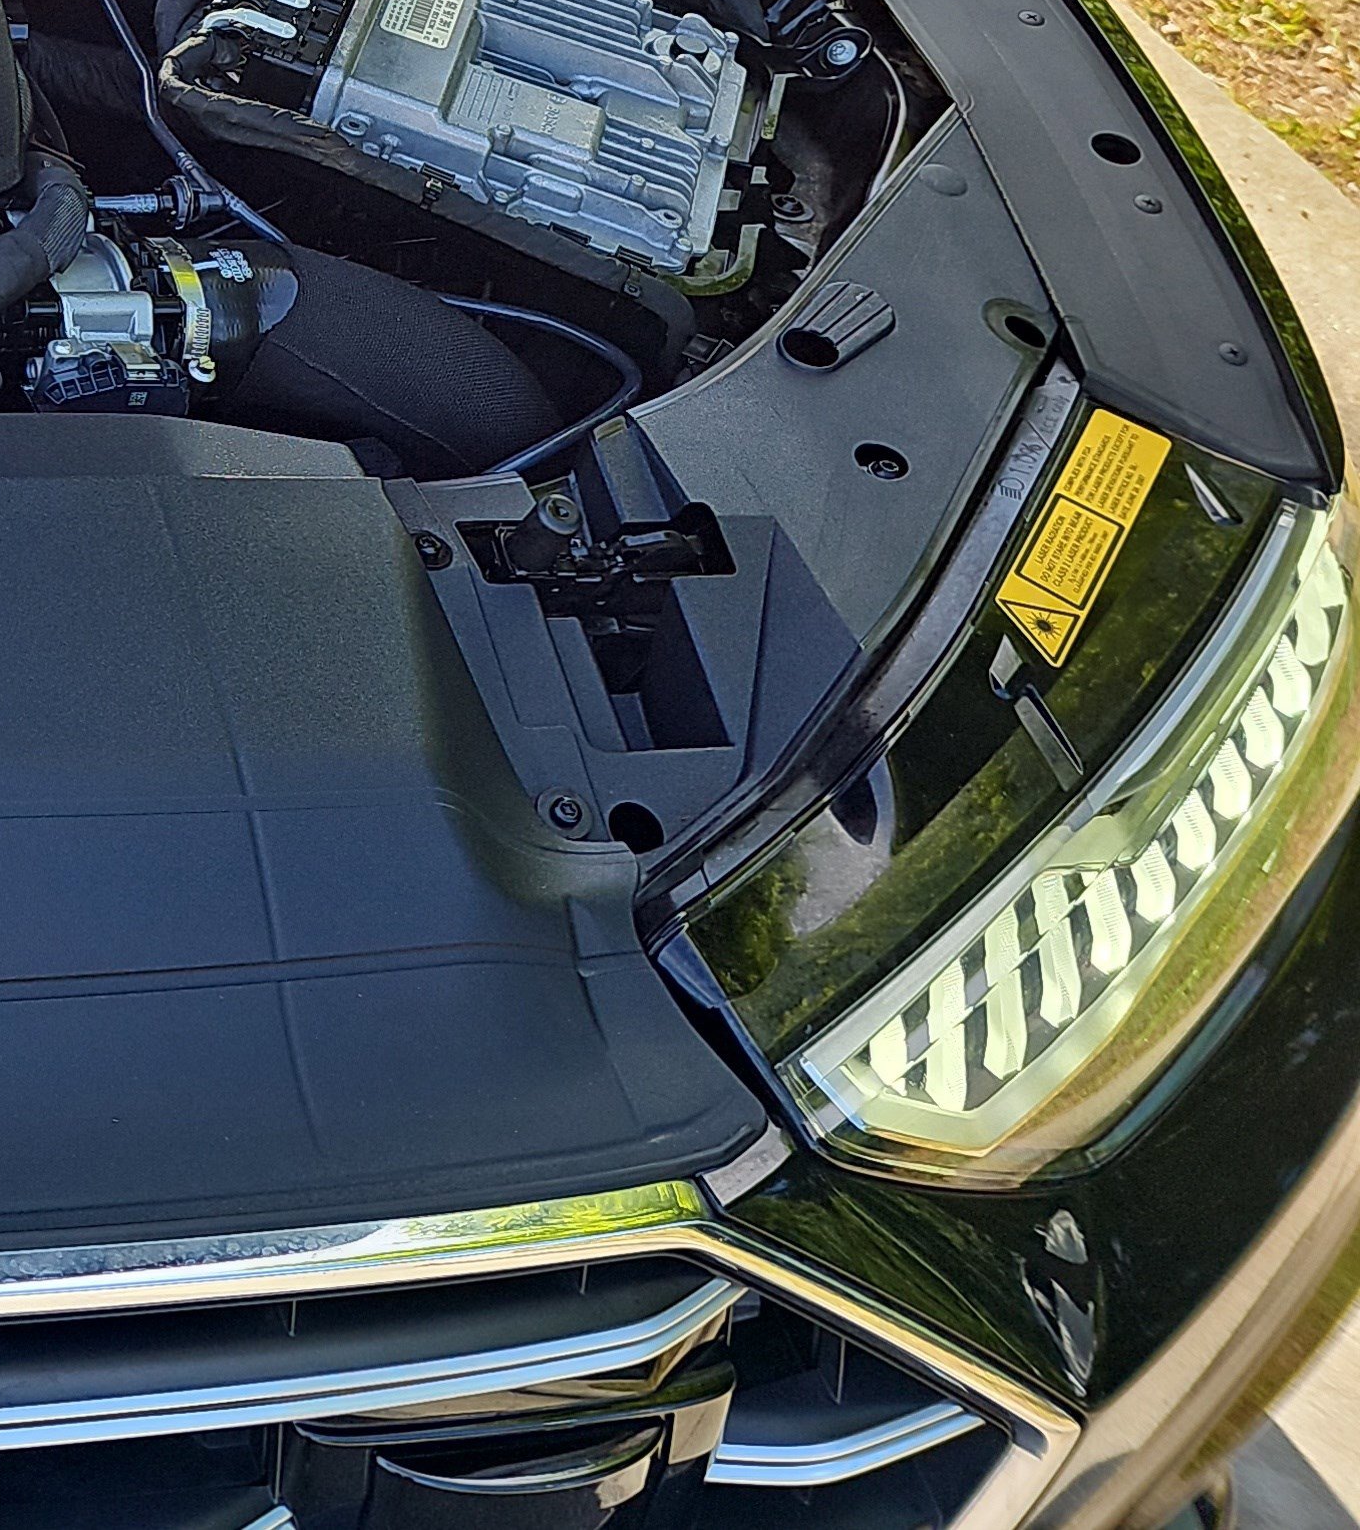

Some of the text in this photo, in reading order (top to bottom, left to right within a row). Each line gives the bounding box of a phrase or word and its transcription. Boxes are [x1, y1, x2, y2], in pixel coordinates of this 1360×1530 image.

[1034, 514, 1065, 563] LASER RADIATION
[1039, 510, 1082, 582] DO NOT STARE INTO BEAM
[1051, 566, 1068, 586] CLASS
[1064, 543, 1080, 562] LASER
[1074, 517, 1093, 543] PRODUCT
